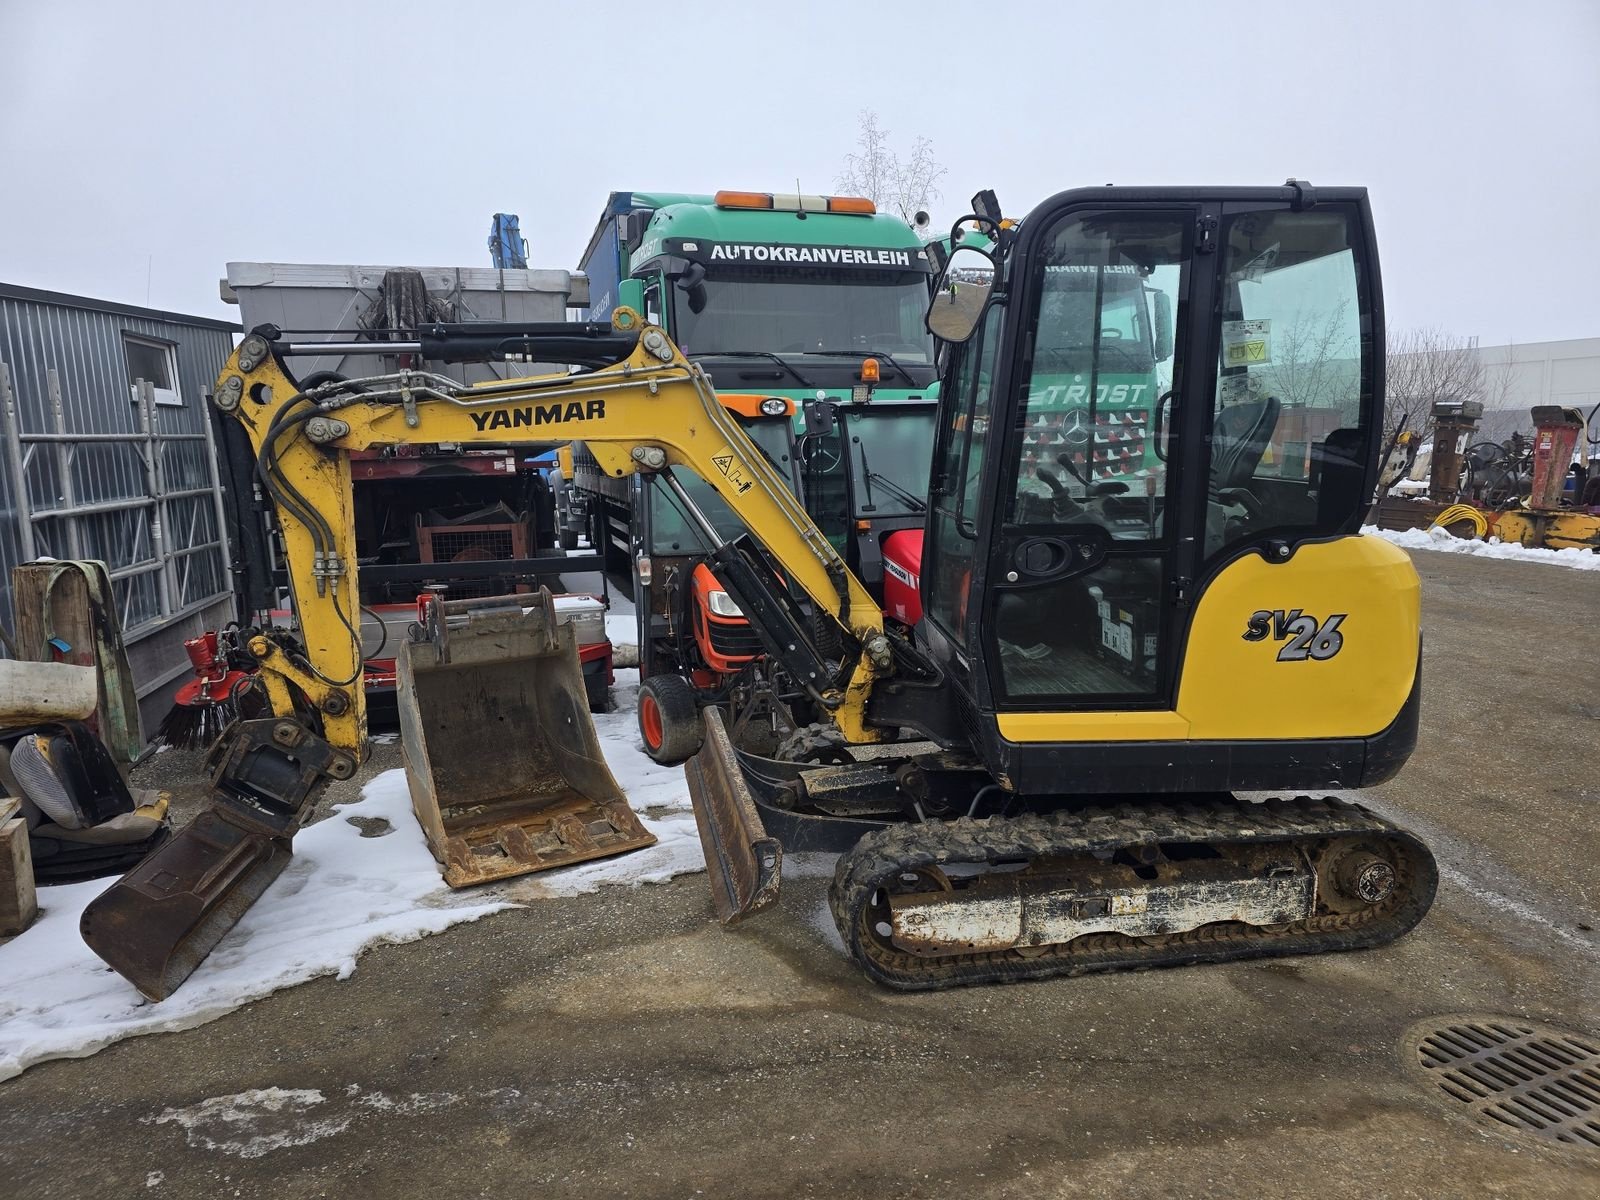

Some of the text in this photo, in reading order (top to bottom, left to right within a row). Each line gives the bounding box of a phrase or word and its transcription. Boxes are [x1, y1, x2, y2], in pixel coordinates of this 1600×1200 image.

[710, 244, 911, 266] AUTOKRANVERLEIH
[1046, 384, 1148, 405] TROST
[469, 399, 606, 431] YANMAR
